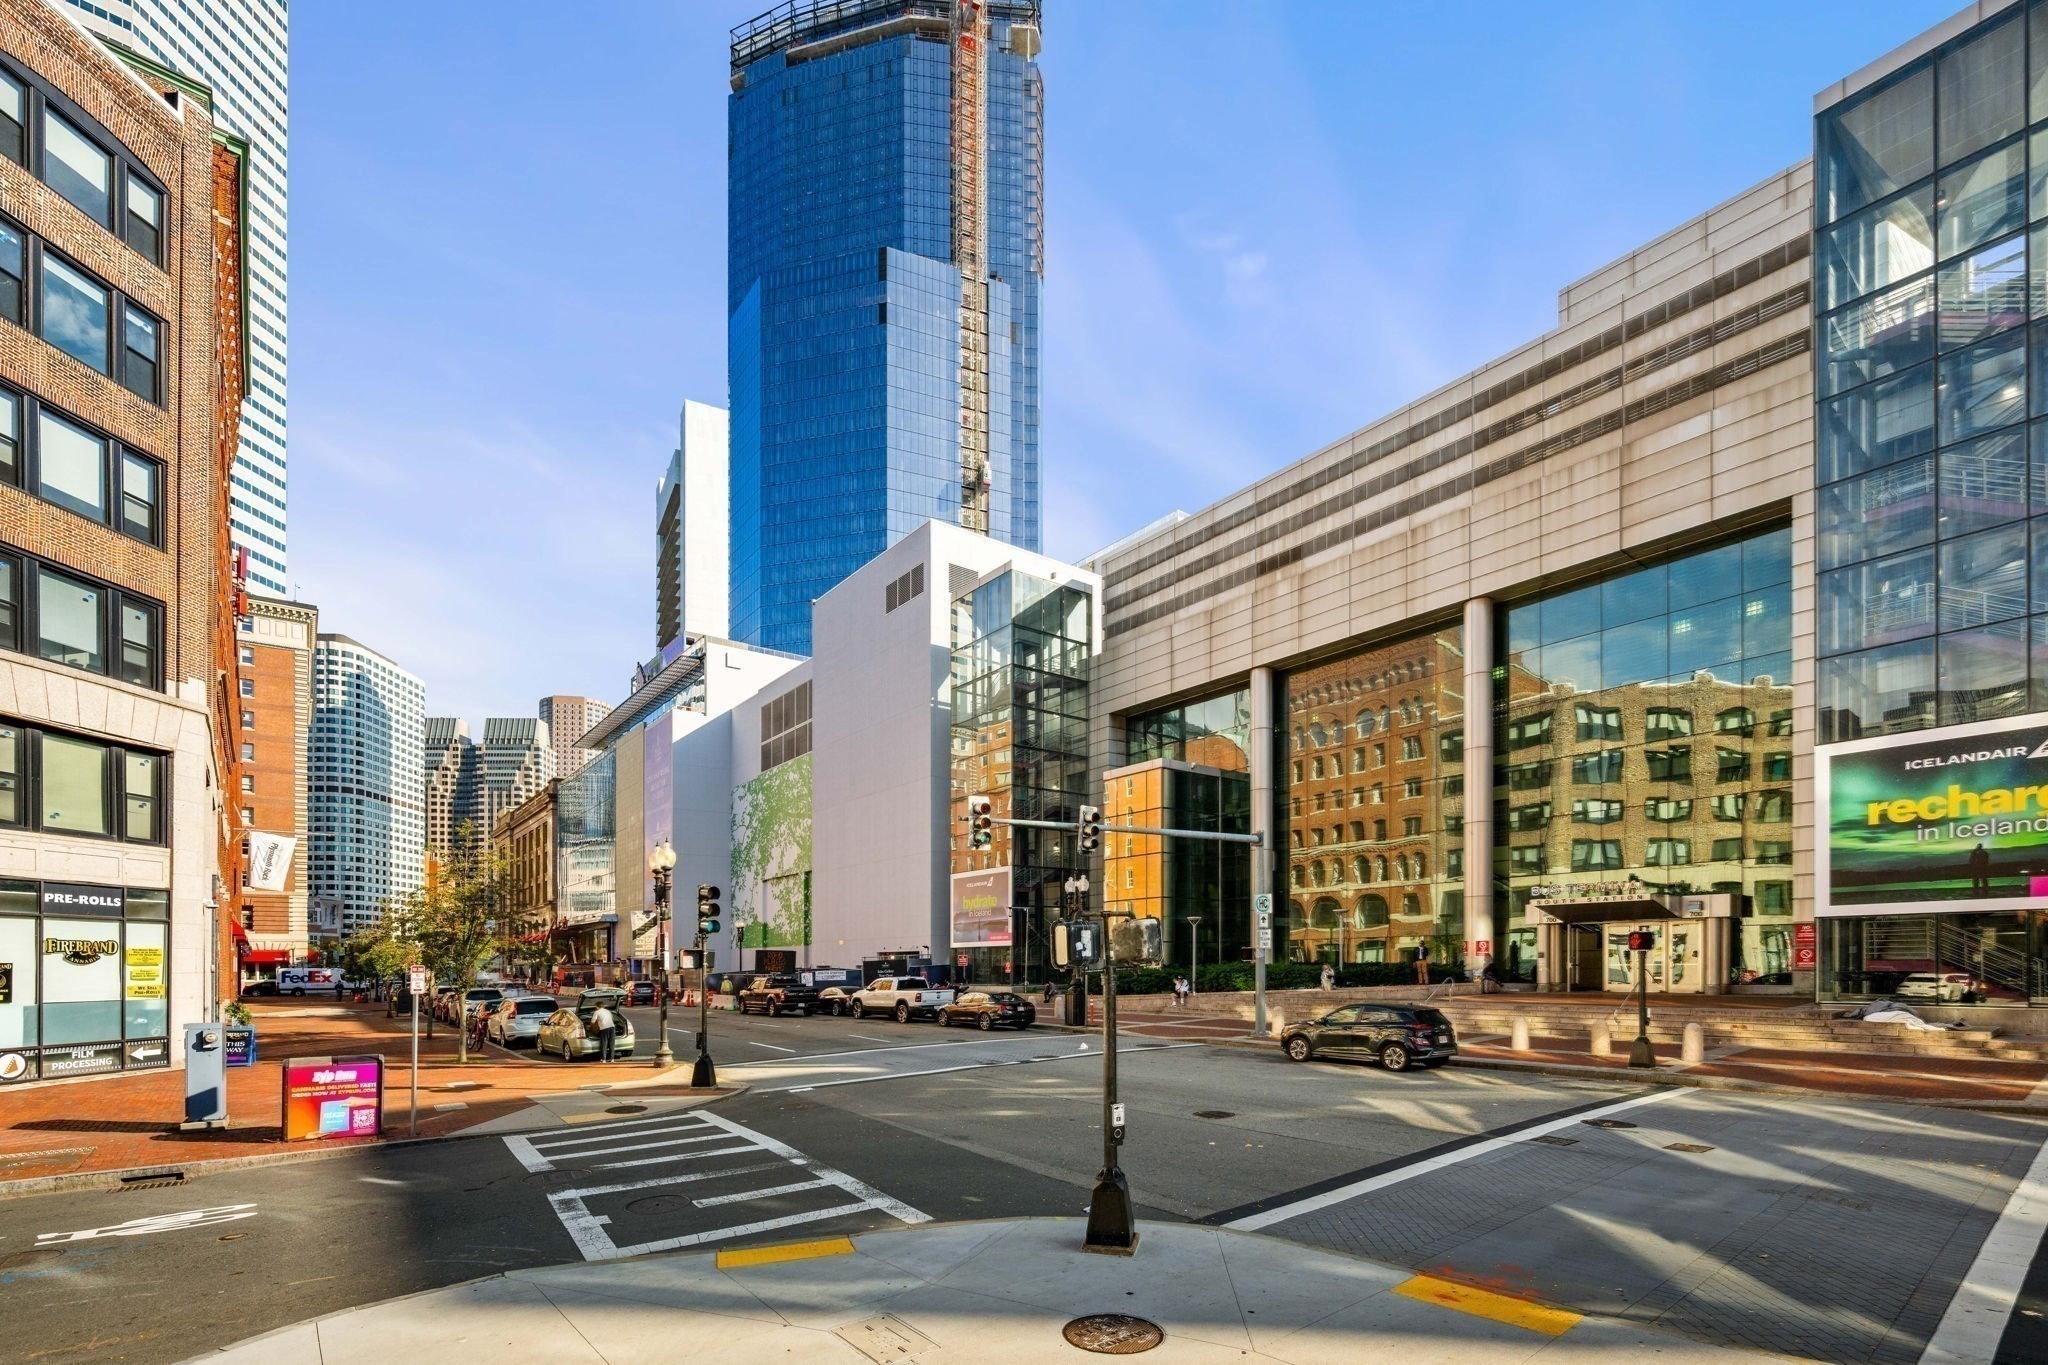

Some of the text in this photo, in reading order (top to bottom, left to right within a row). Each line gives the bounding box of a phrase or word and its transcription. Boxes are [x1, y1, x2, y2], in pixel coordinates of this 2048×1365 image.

[1905, 746, 2028, 770] ICELANDAIR
[1917, 824, 1939, 841] in
[1531, 884, 1562, 897] BUS
[44, 892, 122, 907] PRE-ROLLS
[962, 895, 998, 911] hydrate
[1536, 893, 1644, 906] SOUTH STATION
[974, 909, 992, 917] Iceland
[46, 938, 119, 956] FIREBRAND
[65, 952, 101, 965] CANNABIS
[281, 970, 333, 984] FedEx
[71, 1050, 94, 1060] FILM
[51, 1057, 113, 1071] PROCESSING
[291, 1086, 327, 1094] CANNABIS
[326, 1083, 360, 1091] DELIVERED
